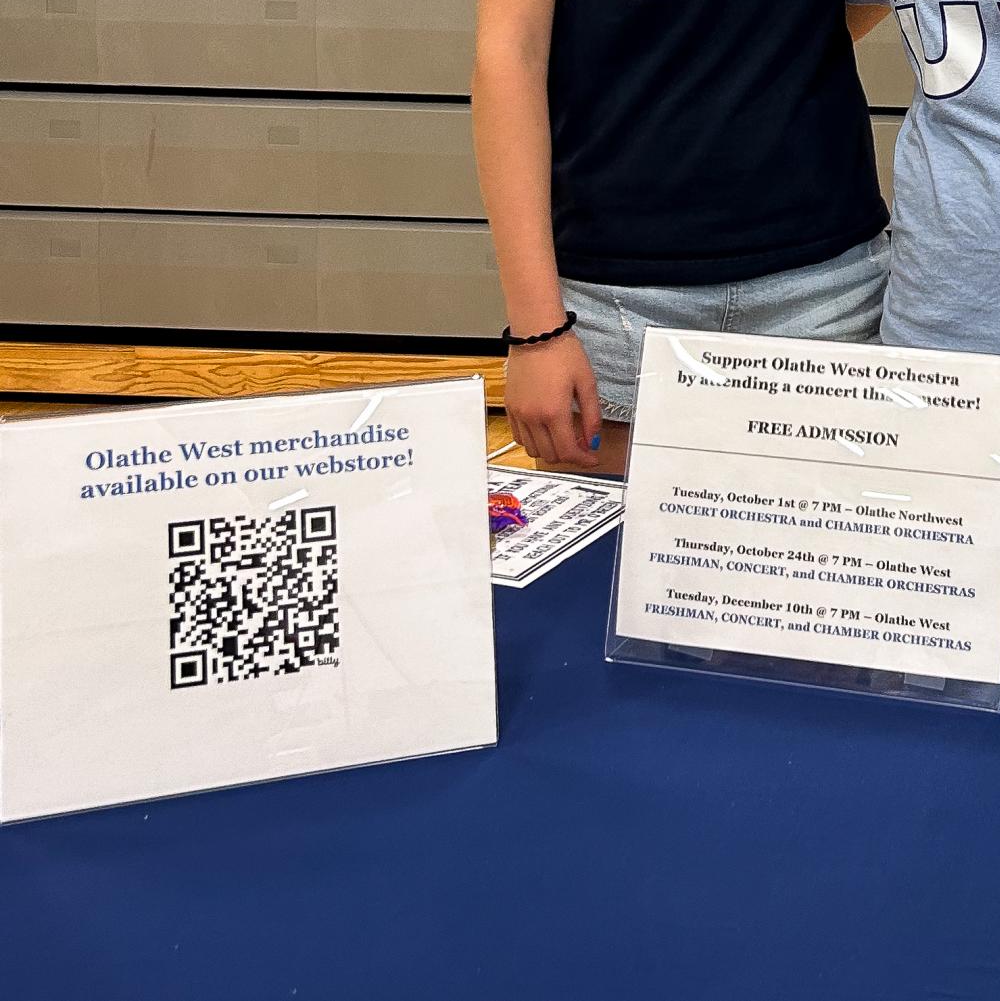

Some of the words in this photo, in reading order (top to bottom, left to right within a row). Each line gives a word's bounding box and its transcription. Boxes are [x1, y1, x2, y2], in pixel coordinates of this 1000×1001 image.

[678, 370, 697, 387] by
[700, 376, 778, 395] aending
[782, 384, 791, 393] a
[796, 385, 858, 399] concert
[702, 351, 767, 370] Support
[771, 357, 826, 374] Olathe
[831, 362, 871, 378] West
[876, 366, 960, 387] Orchestra
[85, 444, 173, 471] Olathe
[178, 439, 244, 462] West
[249, 424, 410, 455] merchandise
[747, 420, 793, 437] FREE
[795, 425, 899, 447] ADMISSION
[80, 471, 198, 499] available
[205, 470, 237, 487] on
[243, 465, 289, 482] our
[295, 449, 414, 477] webstore!
[659, 502, 718, 518] CONCERT
[720, 508, 797, 526] ORCHESTRA
[800, 517, 823, 529] and
[825, 519, 891, 536] CHAMBER
[894, 525, 974, 545] ORCHESTRA
[672, 486, 724, 504] Tuesday,
[727, 491, 775, 507] October
[777, 496, 796, 508] 1st
[797, 499, 809, 510] @
[811, 500, 820, 511] 7
[822, 501, 841, 513] PM
[856, 504, 896, 518] Olathe
[899, 509, 964, 527] Northwest
[649, 552, 724, 571] FRESHMAN,
[726, 560, 790, 578] CONCERT,
[792, 568, 815, 580] and
[818, 570, 884, 588] CHAMBER
[886, 579, 976, 599] ORCHESTRAS
[674, 537, 734, 556] Thursday,
[736, 543, 785, 559] October
[787, 547, 815, 562] 24th
[818, 552, 829, 565] @
[832, 555, 840, 565] 7
[842, 556, 862, 568] PM
[876, 558, 917, 574] Olathe
[919, 566, 951, 578] West
[645, 602, 719, 622] FRESHMAN,
[721, 611, 785, 630] CONCERT,
[787, 621, 811, 633] and
[813, 622, 879, 641] CHAMBER
[882, 631, 972, 652] ORCHESTRAS
[666, 588, 719, 605] Tuesday,
[721, 594, 782, 613] December
[786, 601, 813, 616] 10th
[815, 607, 827, 618] @
[830, 608, 838, 618] 7
[841, 608, 860, 621] PM
[874, 612, 916, 628] Olathe
[918, 618, 951, 632] West
